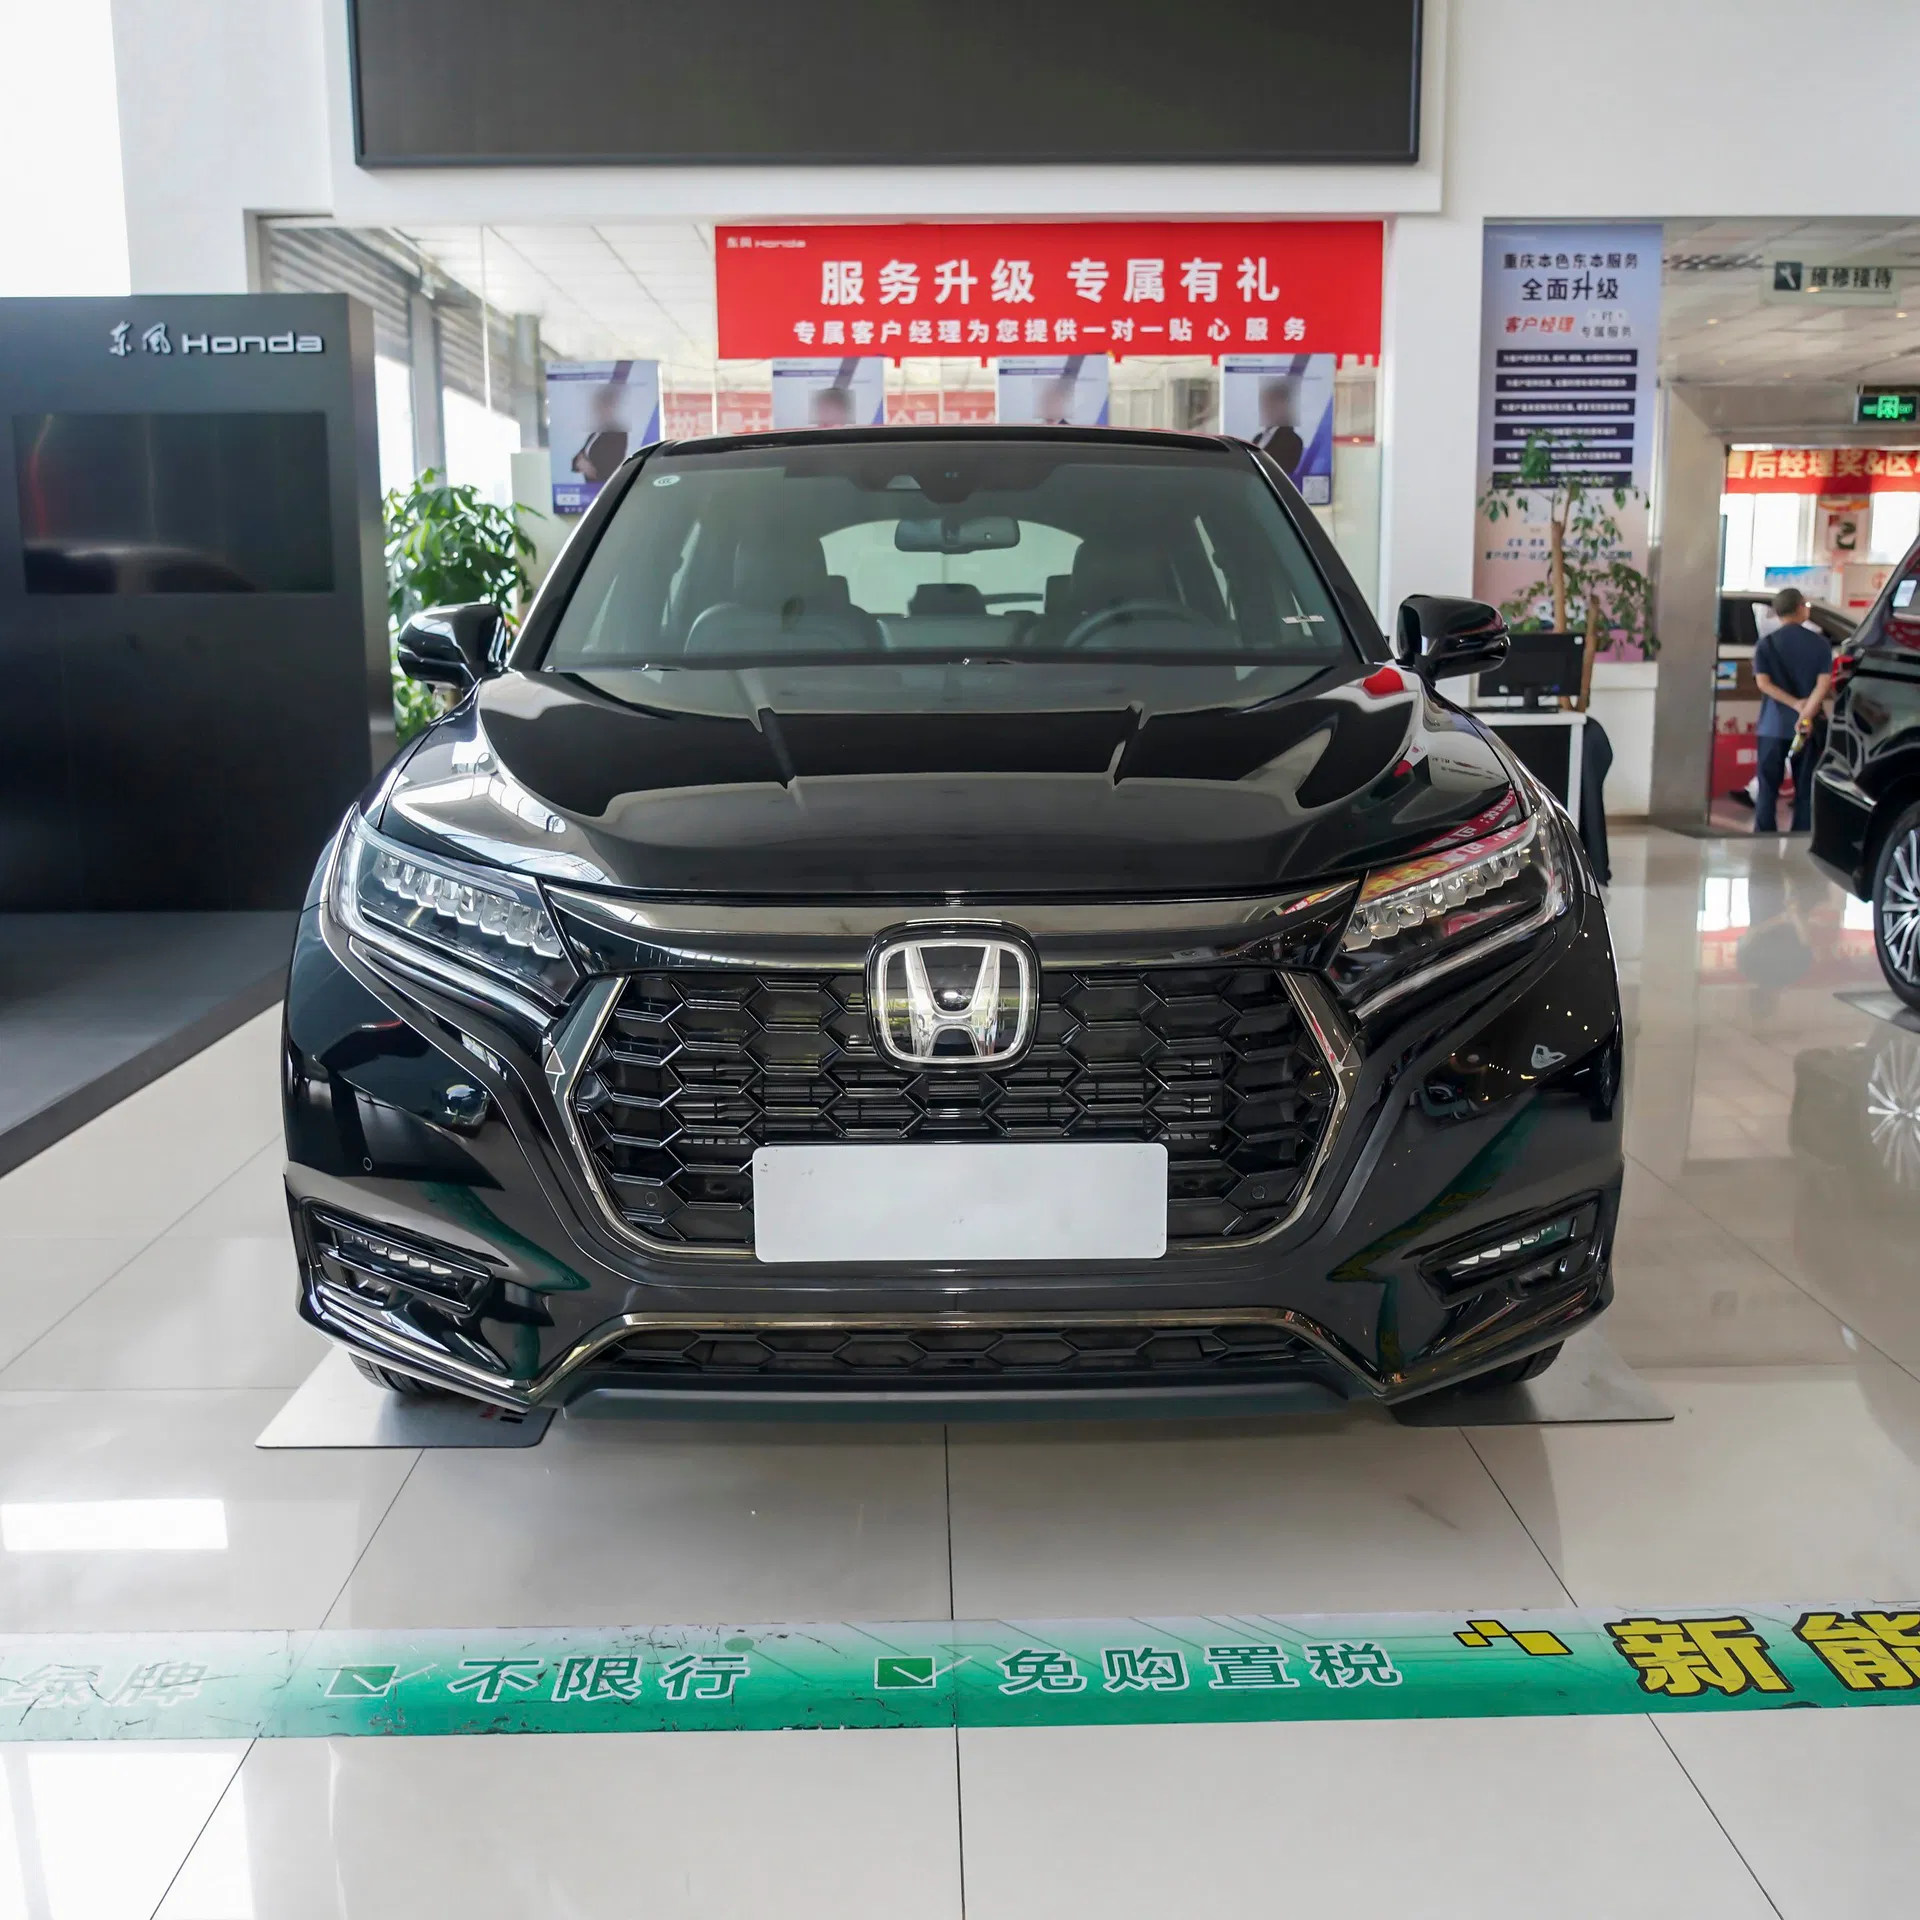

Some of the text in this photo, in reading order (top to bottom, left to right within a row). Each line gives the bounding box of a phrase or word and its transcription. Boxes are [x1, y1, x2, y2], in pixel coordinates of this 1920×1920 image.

[820, 256, 1280, 306] 服务升级 专属有礼
[1521, 270, 1619, 301] 全面升级
[108, 320, 325, 357] 东风 Honda
[1504, 315, 1576, 334] 客户经理
[1727, 449, 1920, 479] 后经理奖&区
[448, 1654, 752, 1703] 不限行
[998, 1642, 1403, 1694] 免购置税
